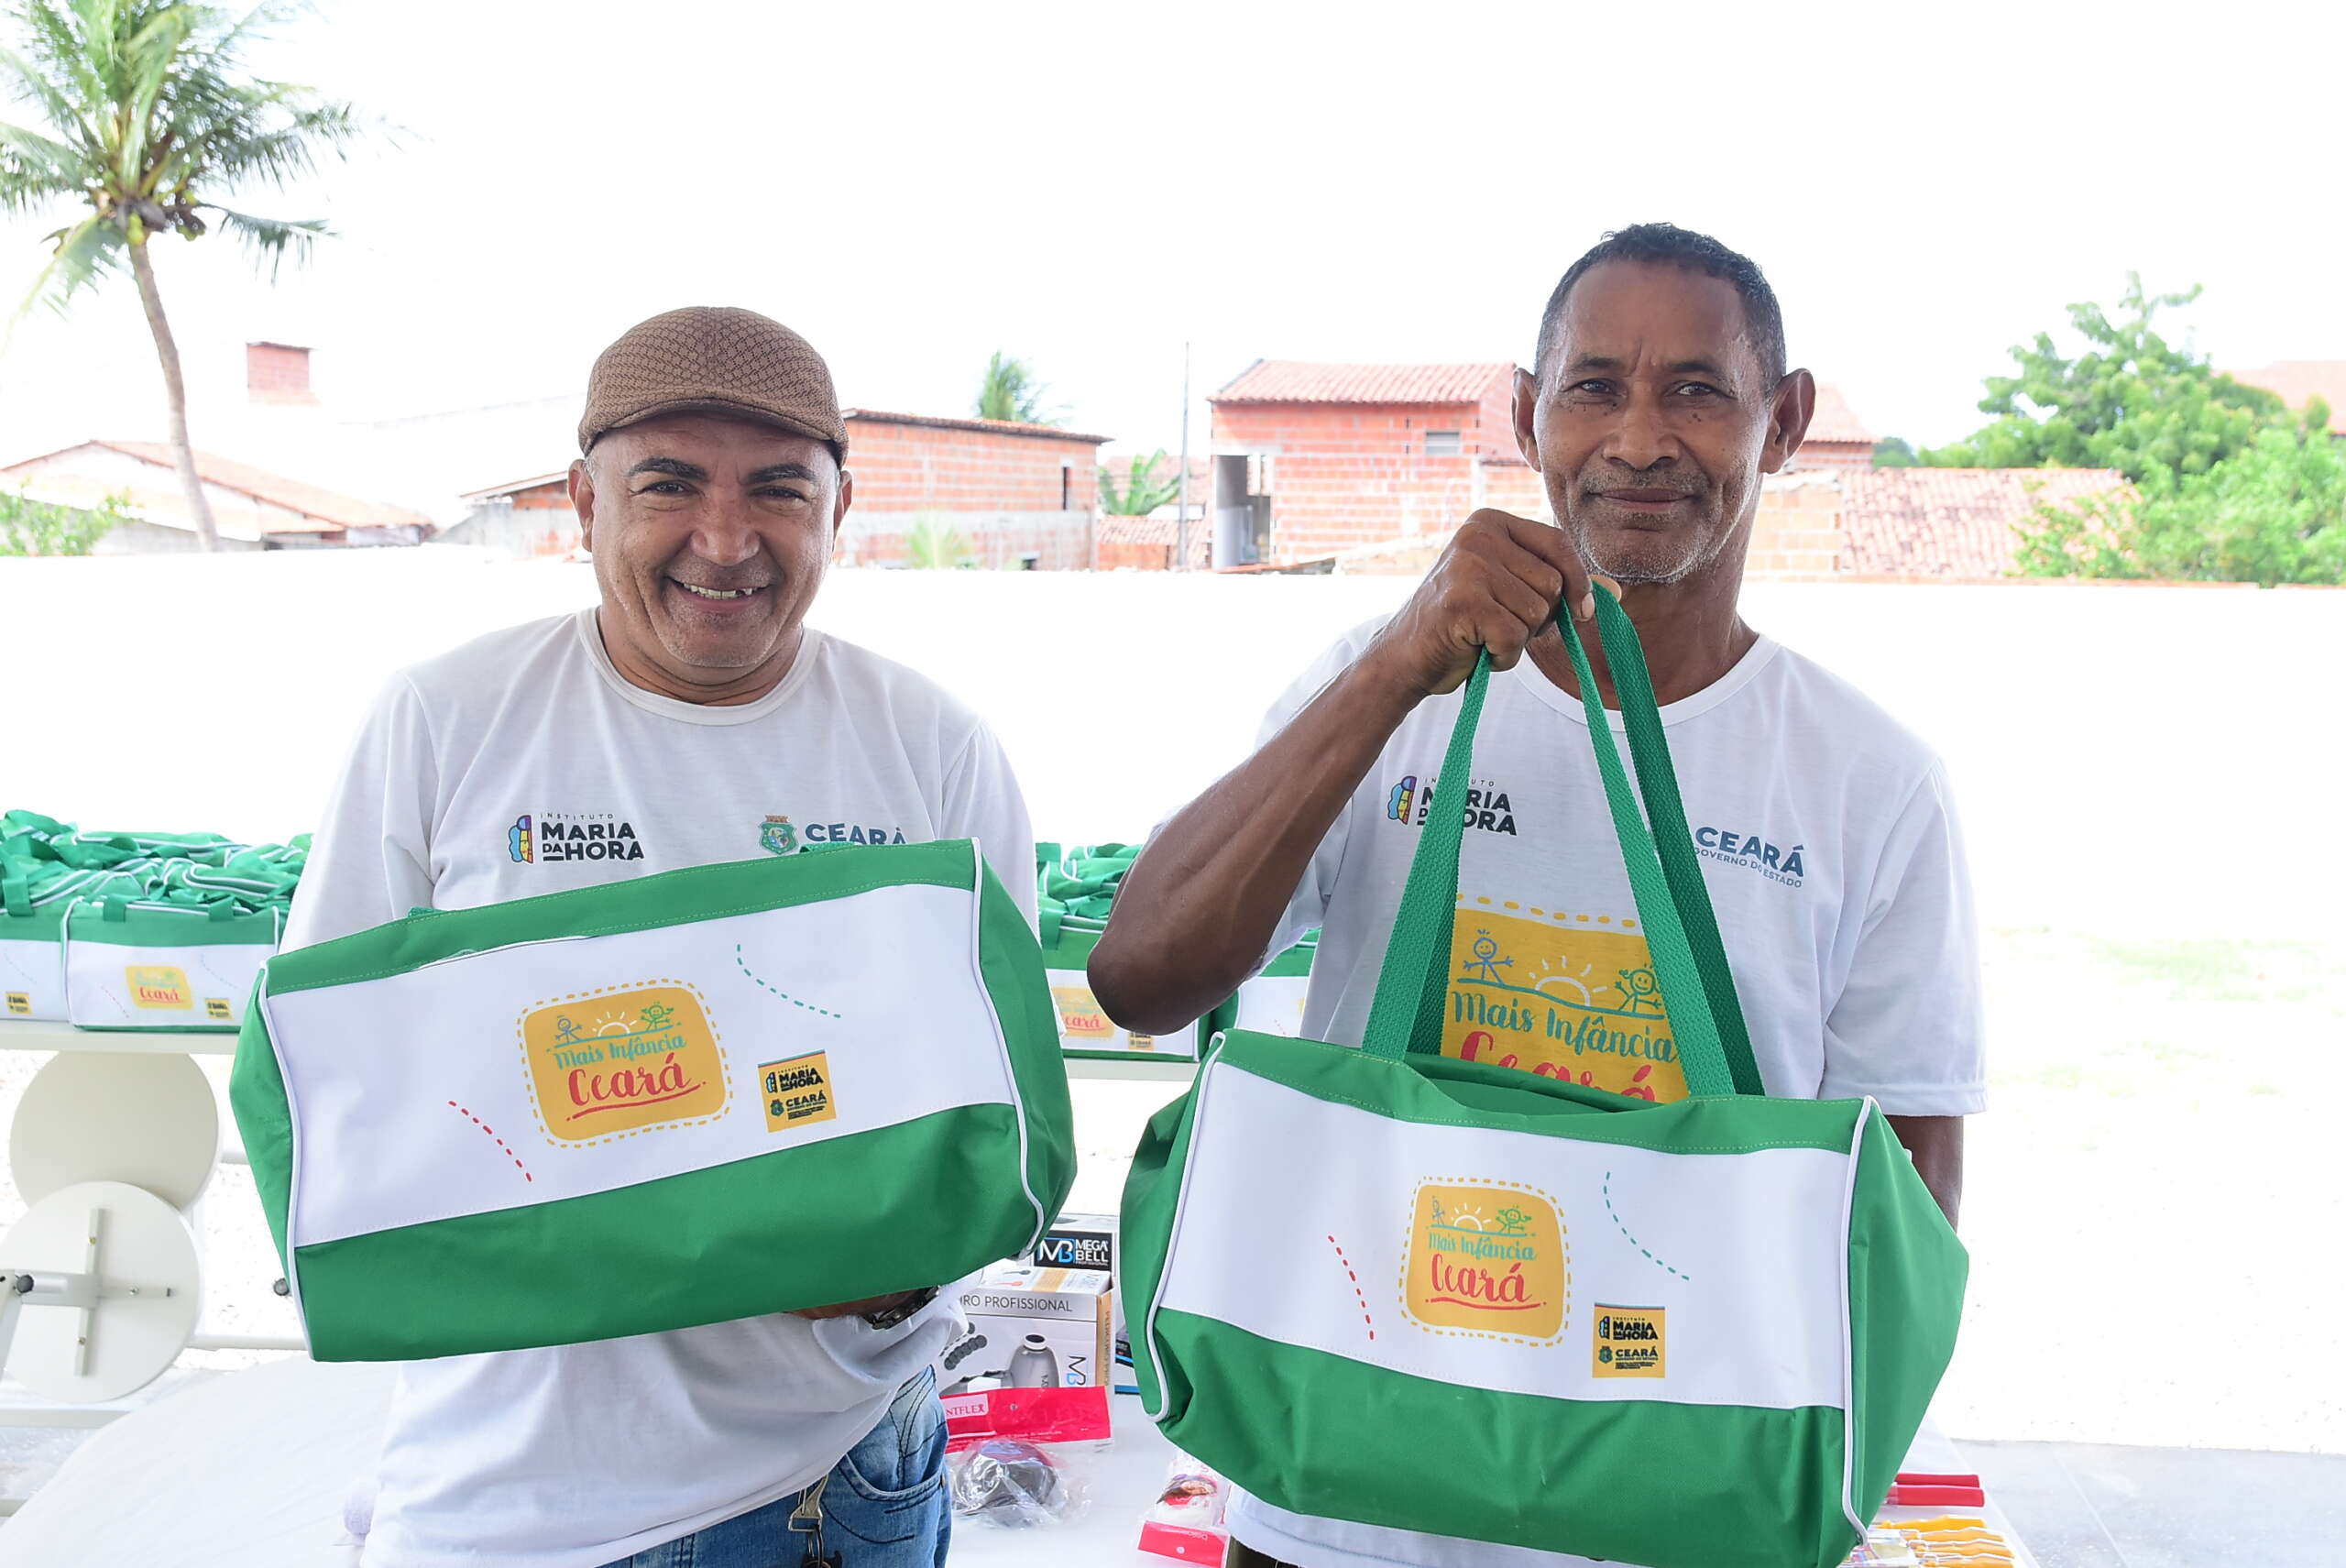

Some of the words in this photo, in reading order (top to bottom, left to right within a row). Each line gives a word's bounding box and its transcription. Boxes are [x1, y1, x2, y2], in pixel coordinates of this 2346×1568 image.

[1425, 777, 1495, 787] INUTO
[1420, 786, 1511, 813] MRIA
[541, 813, 614, 821] INSTITUTO
[1464, 808, 1517, 836] ORA
[541, 821, 636, 840] MARIA
[806, 823, 906, 844] CEARÁ
[1695, 827, 1803, 877] CEARÁ
[1694, 848, 1748, 867] GOVERNO
[1763, 869, 1802, 888] ESTADO
[1452, 990, 1536, 1032] Mais
[1546, 1007, 1678, 1064] Infância
[554, 1045, 604, 1070] Mais
[609, 1034, 687, 1061] Infância
[568, 1052, 692, 1106] Ceará
[779, 1067, 818, 1081] MARIA
[785, 1090, 828, 1107] CEARÁ
[1075, 1238, 1108, 1252] MEGA
[1429, 1233, 1457, 1252] Mais
[1461, 1236, 1537, 1261] Infância
[1075, 1250, 1108, 1263] BELL
[1431, 1253, 1532, 1303] Ceará
[960, 1294, 981, 1307] RO
[984, 1296, 1073, 1312] PROFISSIONAL
[1613, 1321, 1654, 1331] MARIA
[1616, 1345, 1658, 1356] CEARÁ
[946, 1404, 985, 1416] NTFLEX
